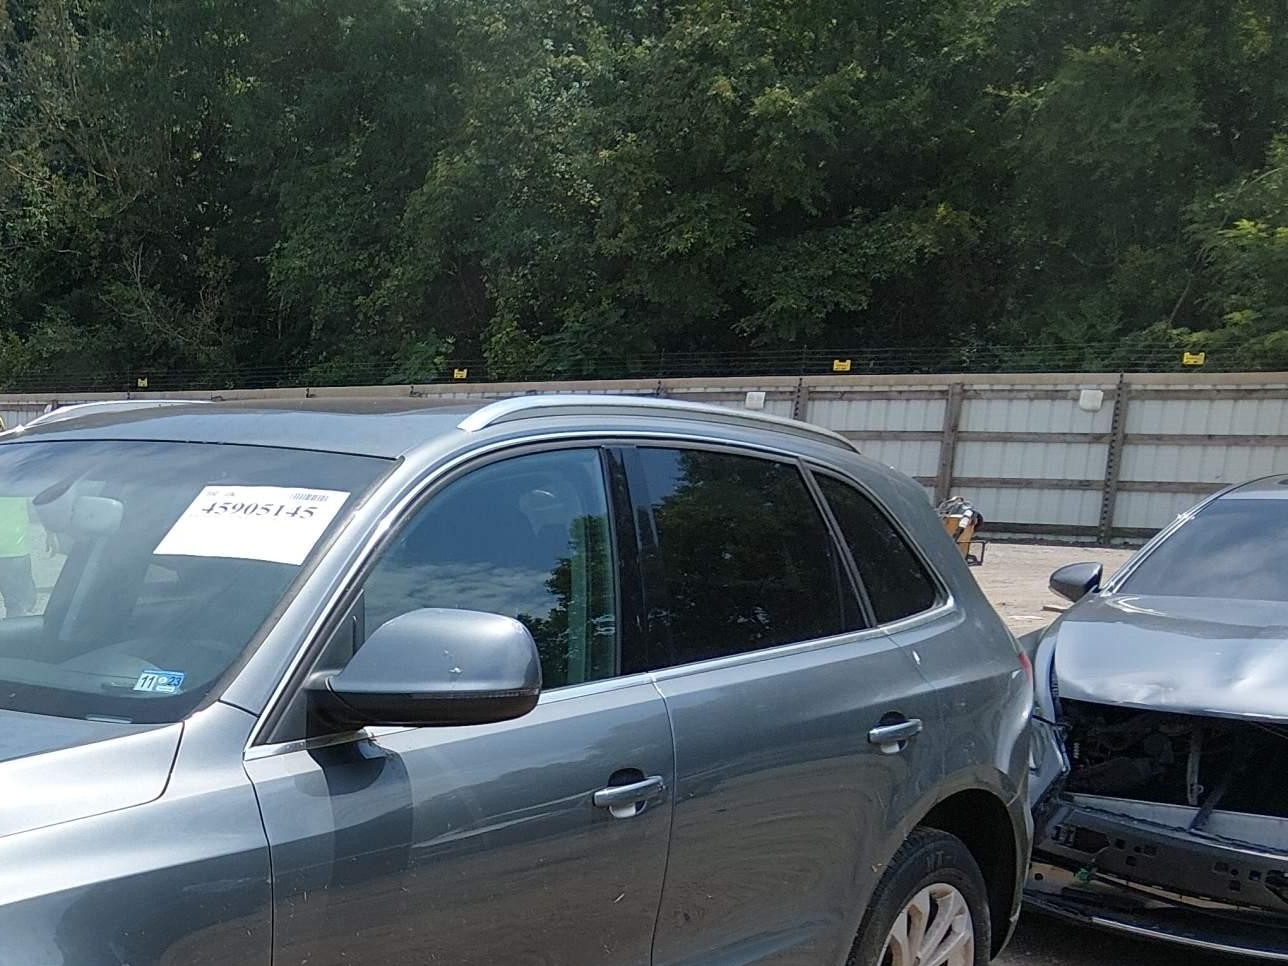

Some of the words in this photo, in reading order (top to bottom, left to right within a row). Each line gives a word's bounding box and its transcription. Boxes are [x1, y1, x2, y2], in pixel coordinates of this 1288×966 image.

[201, 502, 318, 519] 45905145
[140, 675, 156, 689] 11
[167, 676, 182, 687] 23
